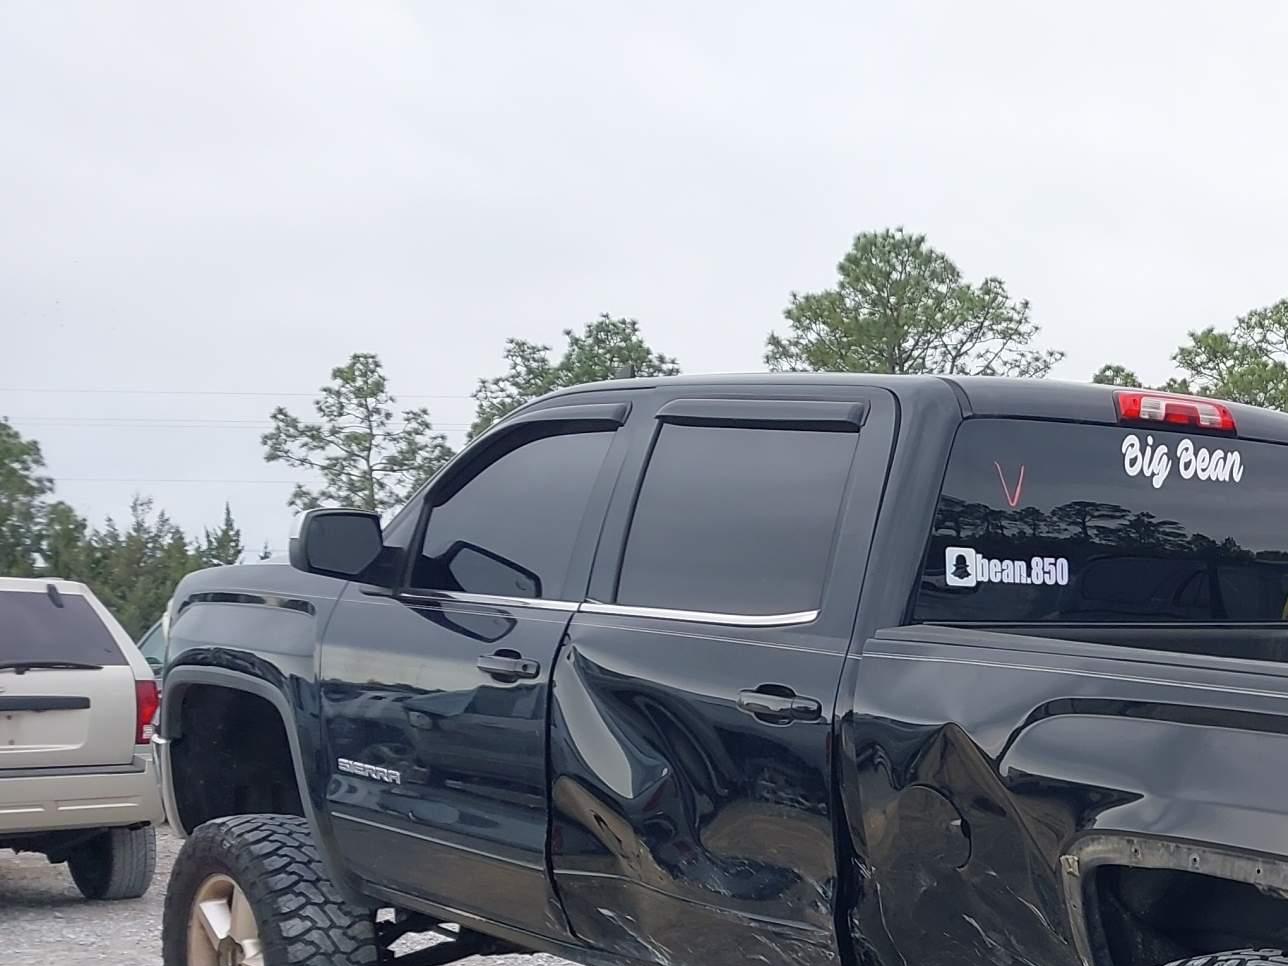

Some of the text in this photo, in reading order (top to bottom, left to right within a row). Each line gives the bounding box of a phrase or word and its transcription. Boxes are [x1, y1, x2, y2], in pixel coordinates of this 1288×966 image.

[1122, 435, 1244, 489] Big Bean
[974, 552, 1069, 586] bean.850
[337, 757, 401, 785] SIERRA
